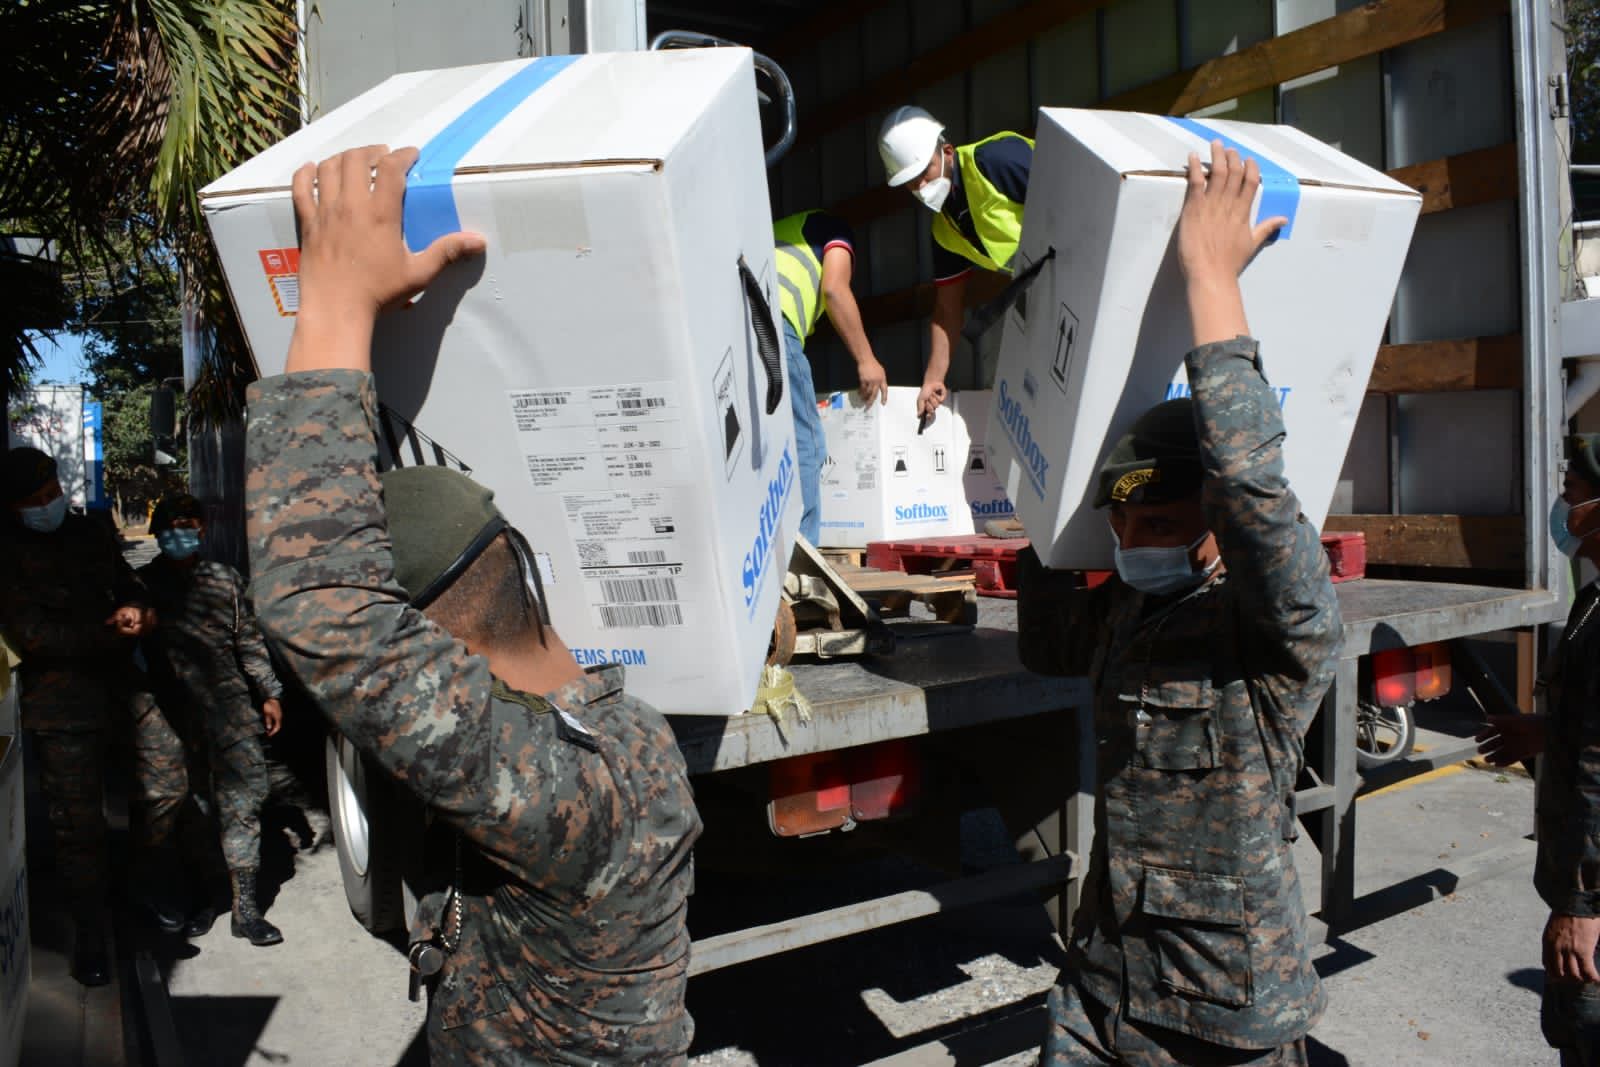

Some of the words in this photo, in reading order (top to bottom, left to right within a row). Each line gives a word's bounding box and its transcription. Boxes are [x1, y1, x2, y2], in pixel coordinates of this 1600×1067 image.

[998, 379, 1049, 491] Softbox
[743, 440, 794, 606] Softbox
[895, 503, 948, 520] Softbox
[971, 498, 1014, 514] Softb
